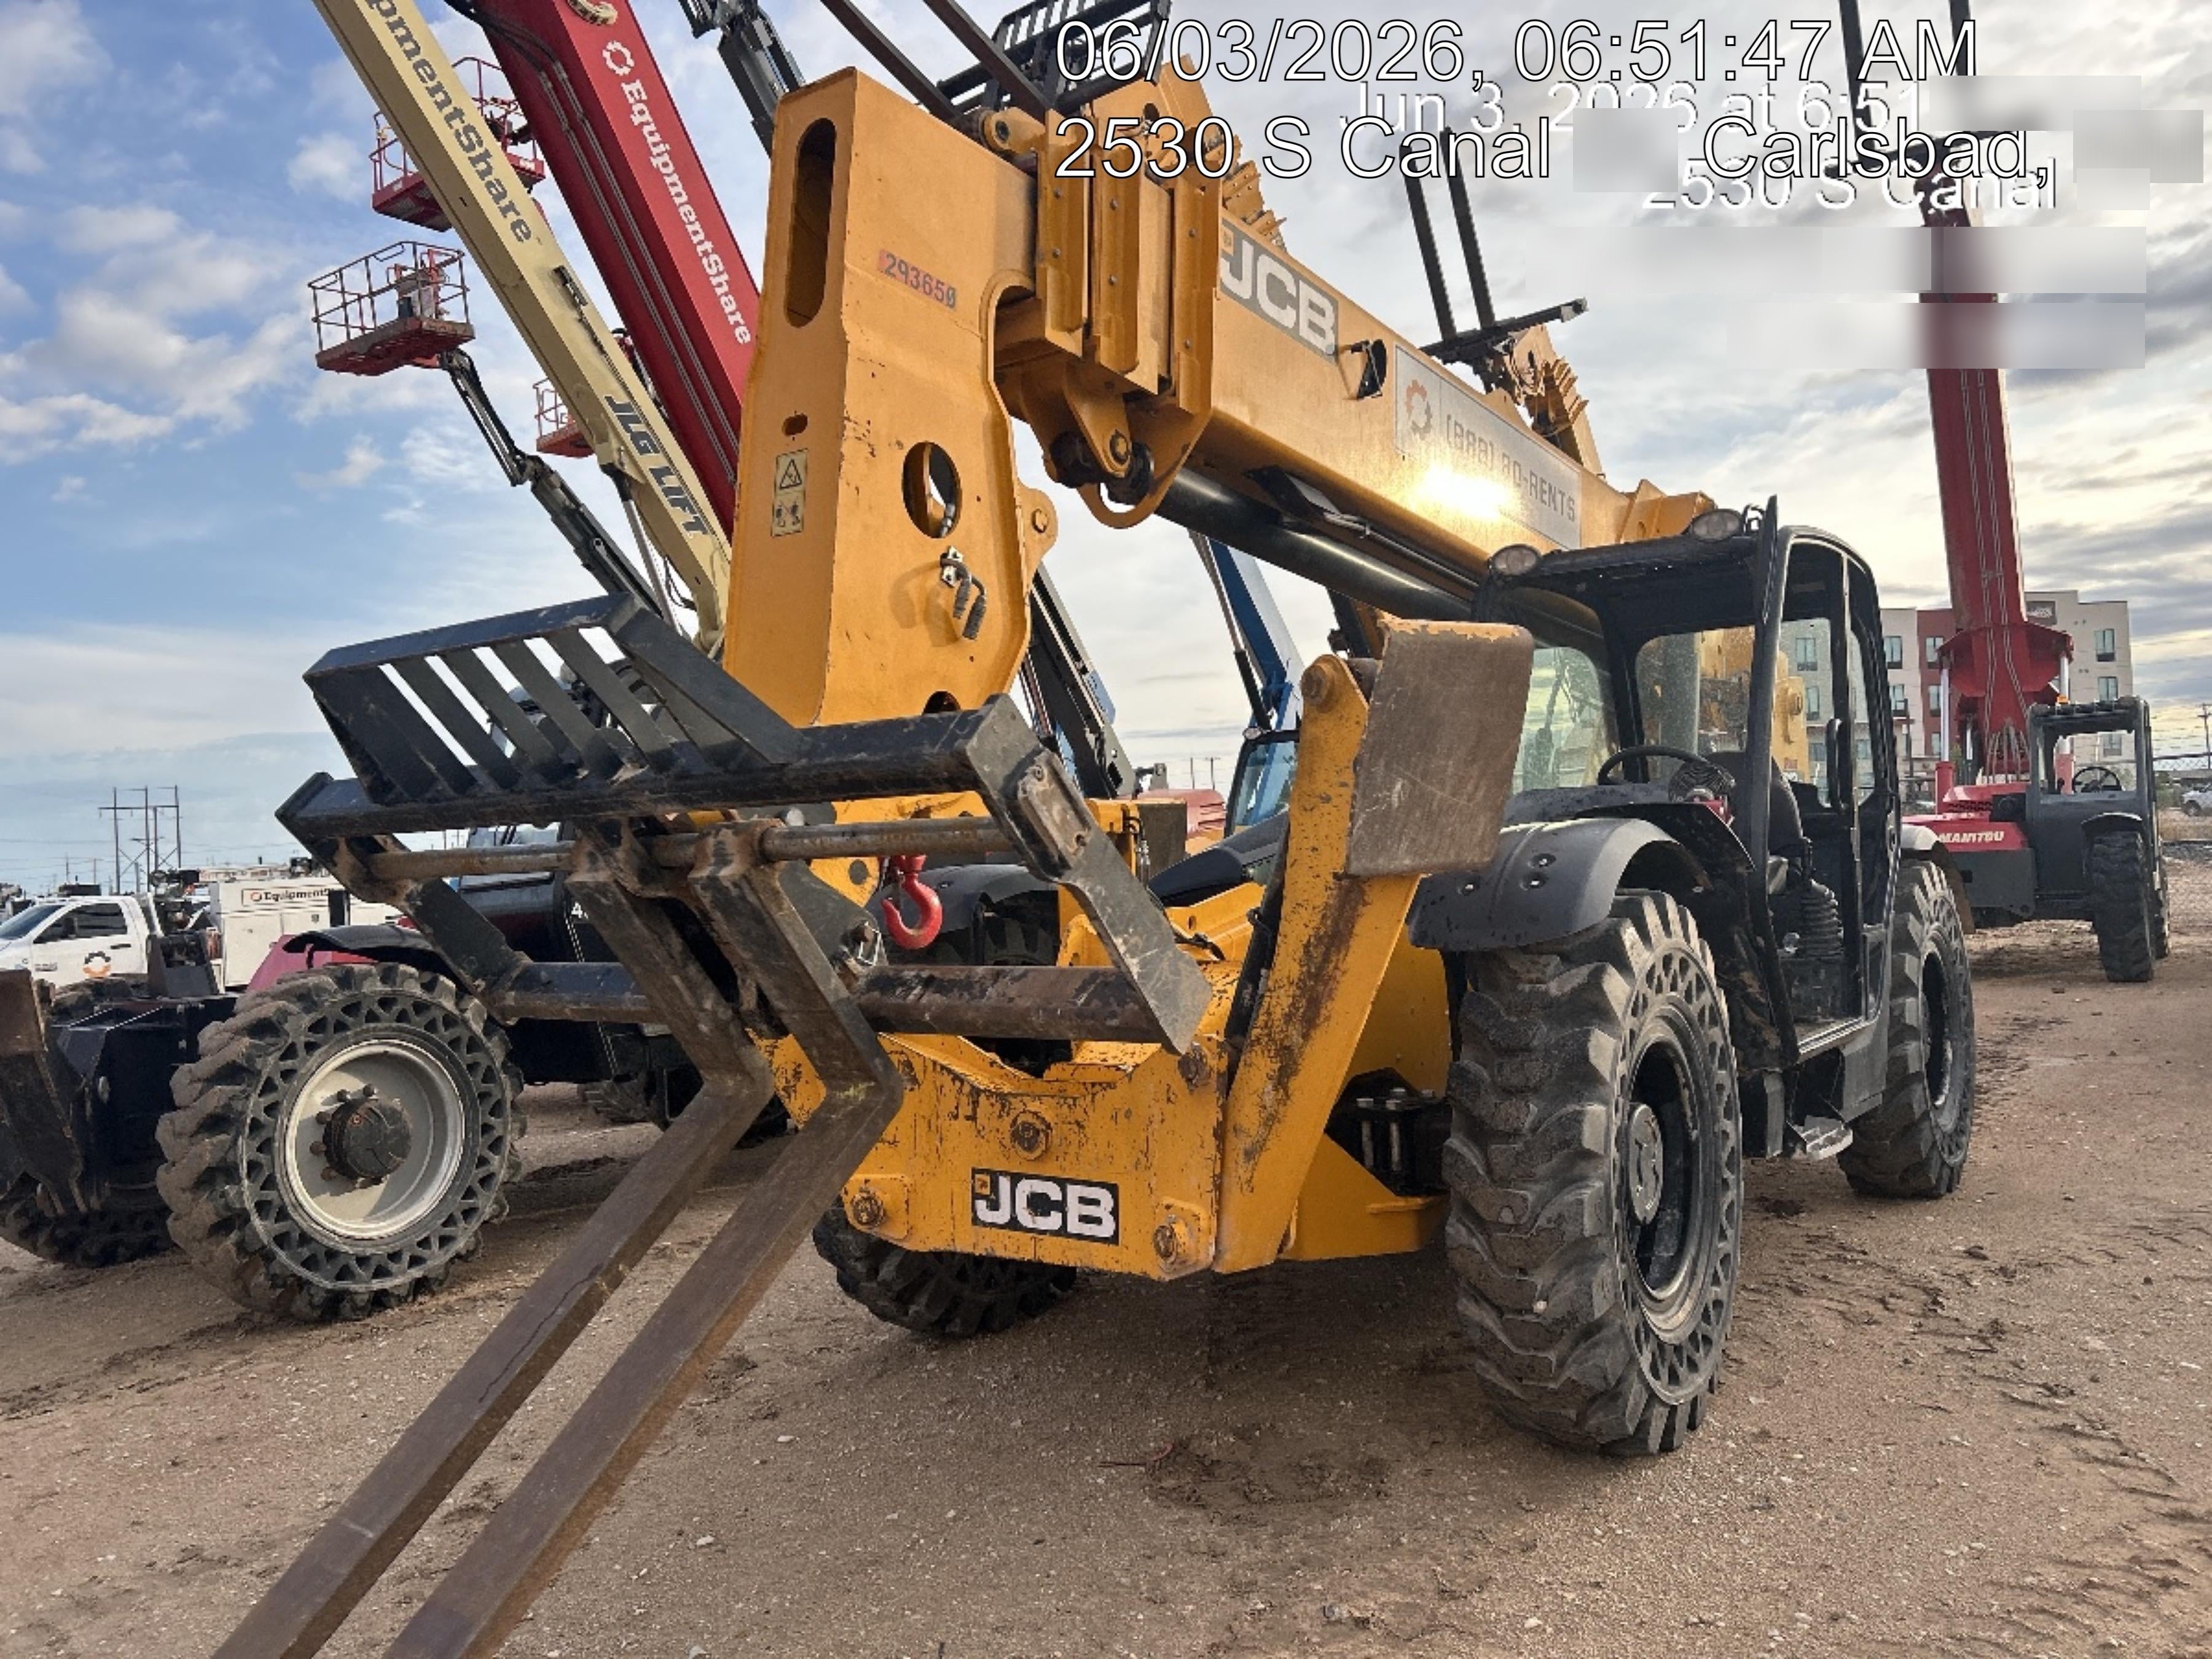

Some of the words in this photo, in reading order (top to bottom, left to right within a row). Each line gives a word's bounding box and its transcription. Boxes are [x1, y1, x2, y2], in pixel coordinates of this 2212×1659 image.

[621, 79, 751, 344] EquipmentShare
[1220, 239, 1335, 355] JCB
[604, 396, 661, 456] JLG
[648, 466, 709, 535] LIFT
[1939, 831, 2004, 843] MANITOU
[975, 1175, 1116, 1237] JCB
